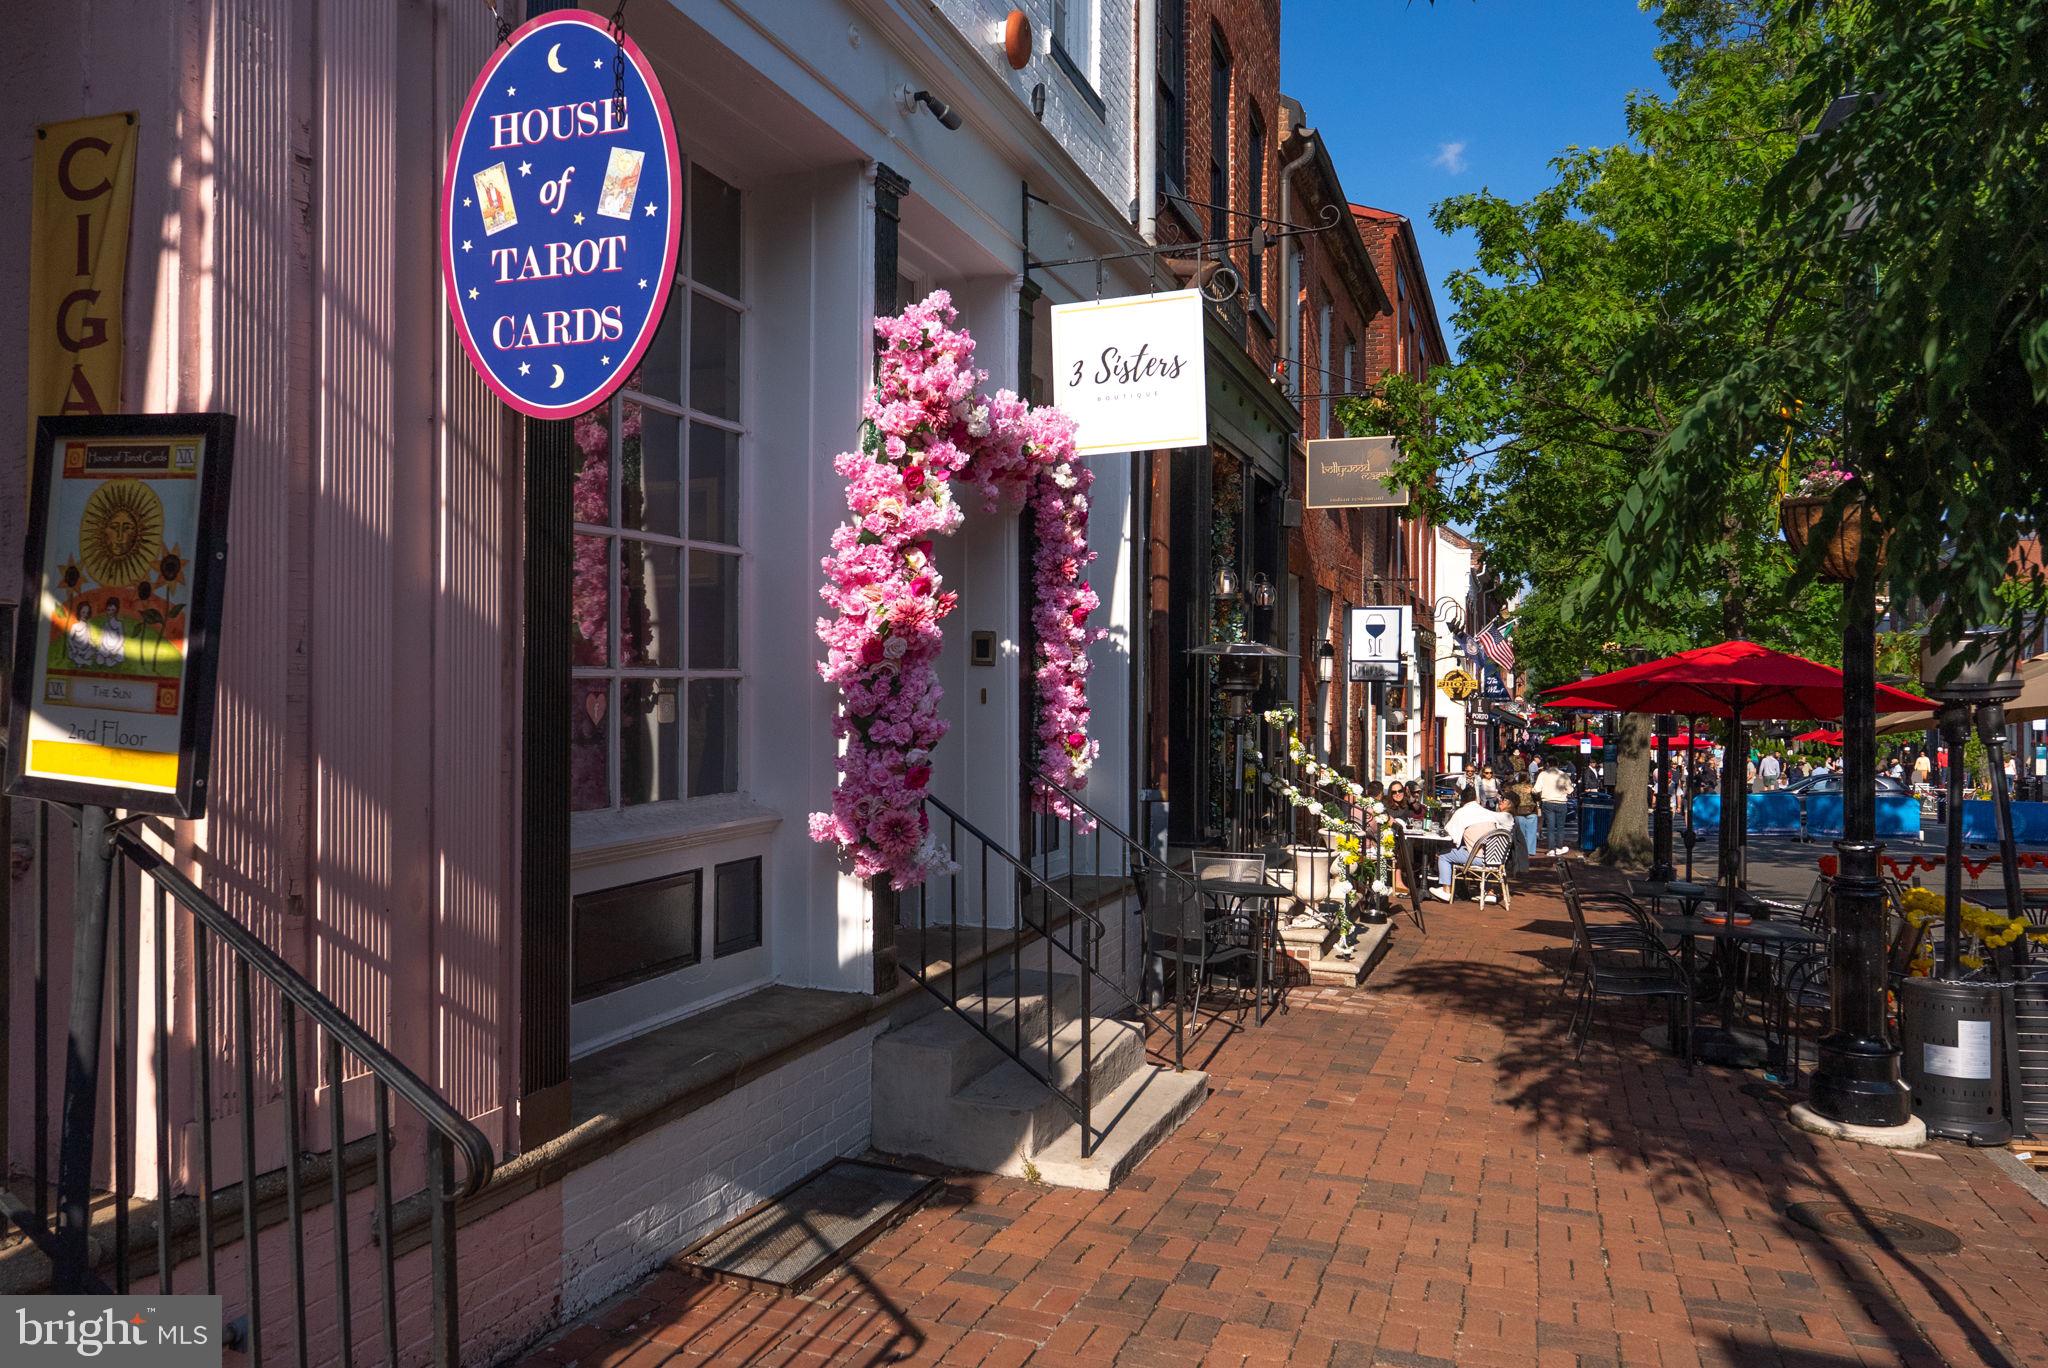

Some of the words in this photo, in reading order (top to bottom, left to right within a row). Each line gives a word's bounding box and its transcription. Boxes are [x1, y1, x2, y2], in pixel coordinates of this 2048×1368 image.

[489, 96, 629, 149] HOUSE
[538, 165, 576, 214] of
[491, 235, 627, 283] TAROT
[492, 305, 623, 350] CARDS
[1069, 359, 1084, 387] 3
[1094, 343, 1188, 384] Sisters
[1097, 390, 1159, 402] BOUTIQUE
[88, 451, 112, 463] House
[113, 451, 121, 462] of
[120, 451, 142, 463] Tarot
[143, 451, 168, 463] Cards
[92, 685, 109, 698] THE
[1438, 681, 1478, 689] SHOES
[68, 719, 97, 742] 2nd
[102, 720, 148, 747] Floor
